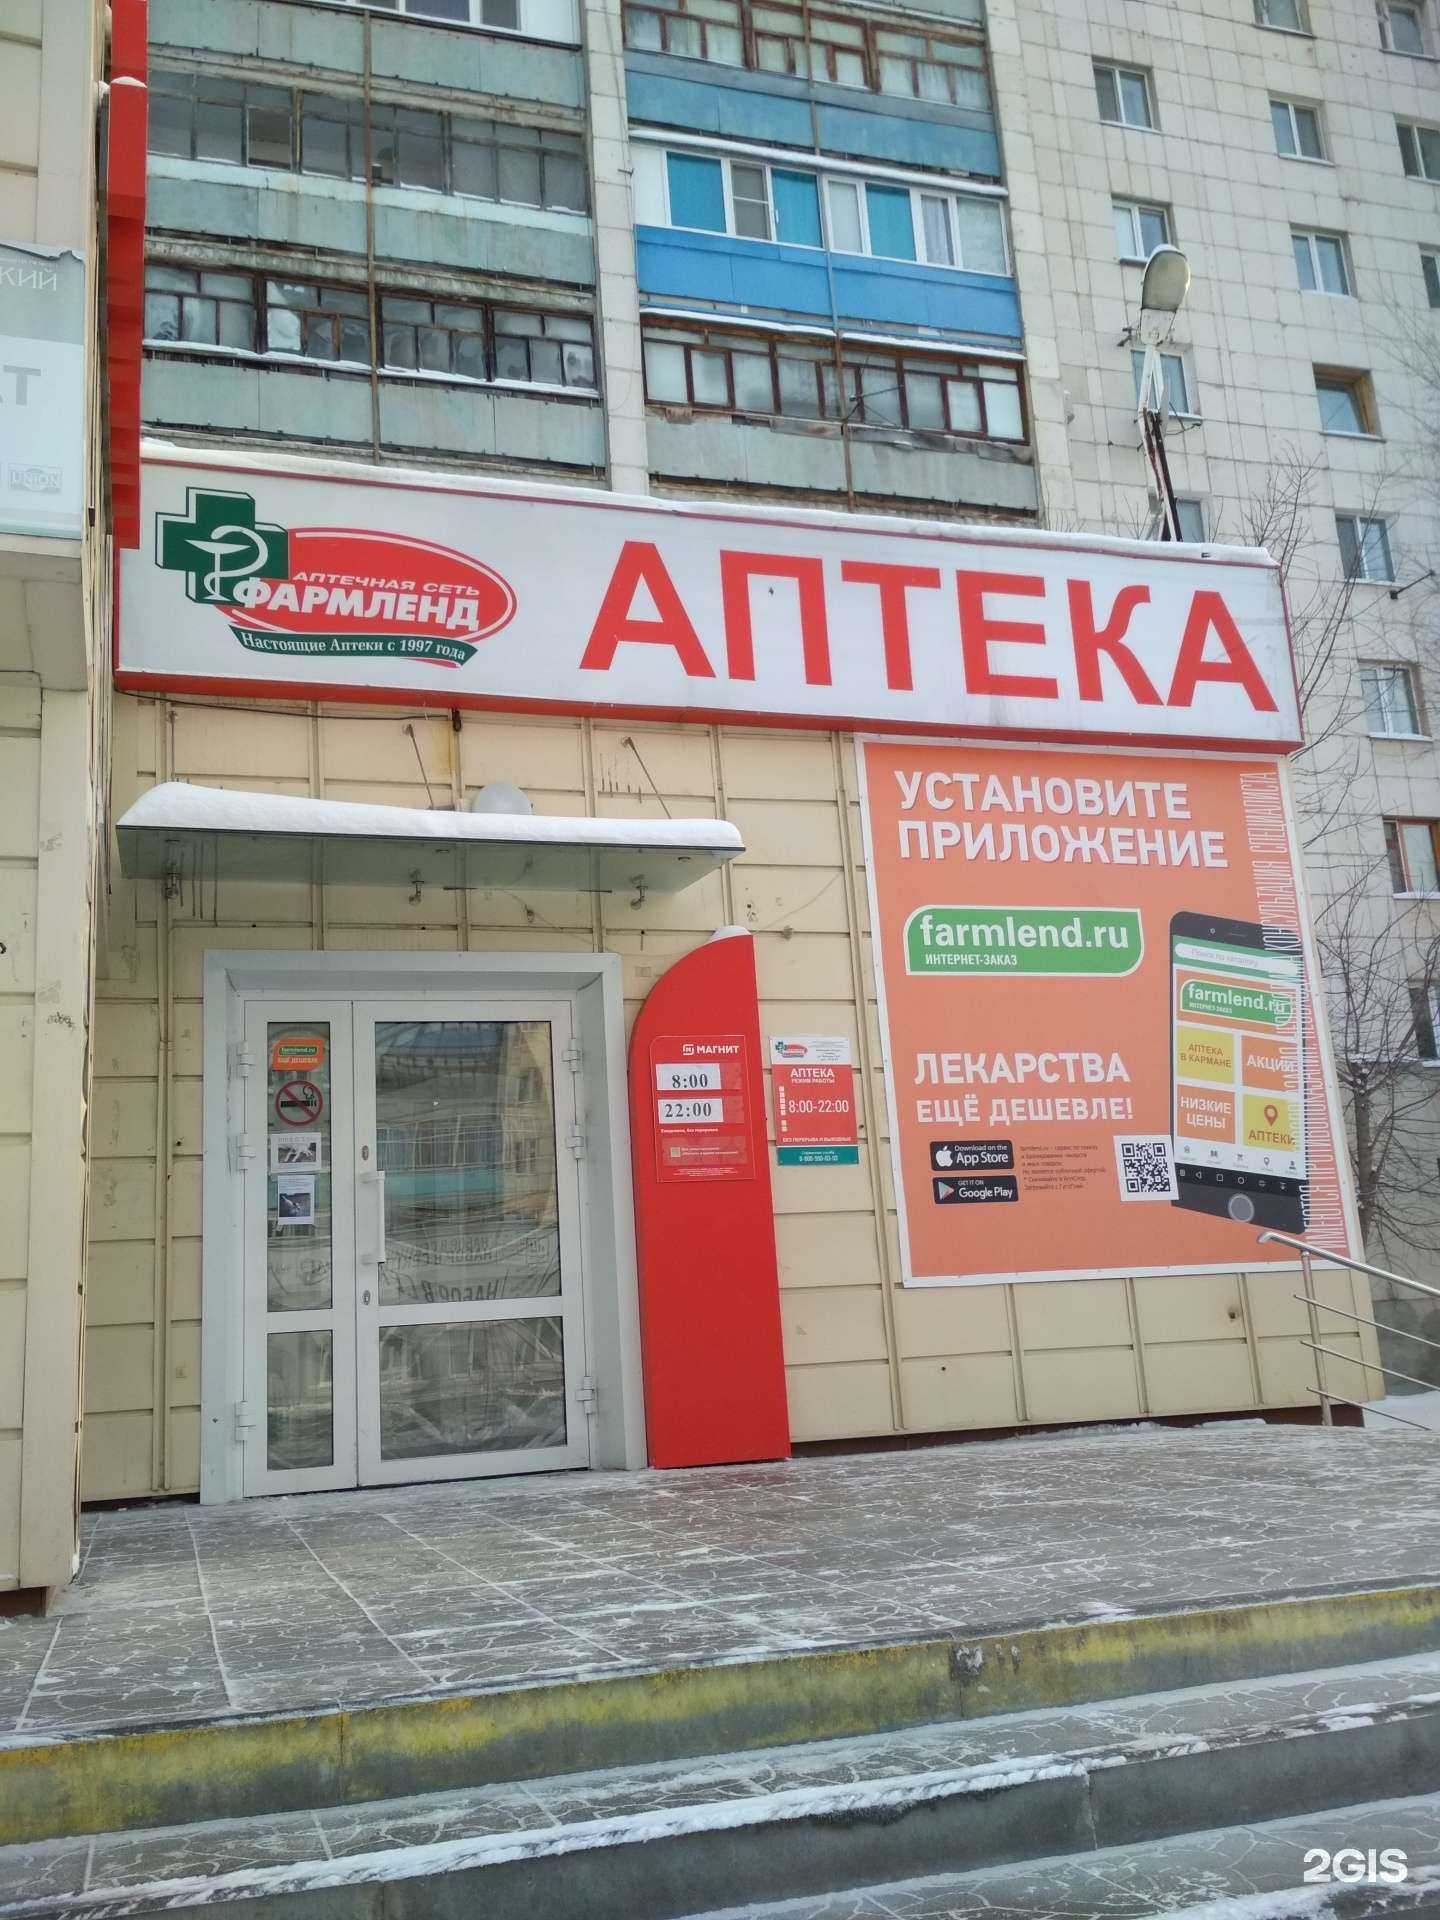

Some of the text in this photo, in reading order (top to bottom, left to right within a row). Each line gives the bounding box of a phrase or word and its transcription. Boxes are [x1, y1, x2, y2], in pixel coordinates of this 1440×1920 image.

[293, 571, 481, 596] АПТЕЧНАЯ СЕТЬ
[232, 576, 480, 632] ФАРМЛЕНД
[579, 539, 1280, 712] АПТЕКА
[241, 632, 466, 661] Настоящие Аптеки с 1997 года
[895, 770, 1192, 819] УСТАНОВИТЕ
[1240, 771, 1288, 854] СПЕЦИАЛИСТА
[898, 820, 1228, 868] ПРИЛОЖЕНИЕ
[1252, 860, 1304, 951] КОНСУЛЬТАЦИЯ
[919, 914, 1129, 949] farmlend.ru
[925, 953, 1018, 966] ИНТЕРНЕТ-ЗАКАЗ
[1187, 983, 1285, 1013] farmlend.ru
[697, 1045, 740, 1054] МАГНИТ
[1180, 1053, 1232, 1068] В КАРМАНЕ
[1188, 1043, 1223, 1056] АПТЕКА
[790, 1068, 835, 1078] АПТЕКА
[914, 1053, 1132, 1084] ЛЕКАРСТВА
[671, 1073, 708, 1088] 8:00
[664, 1102, 712, 1118] 22:00
[788, 1099, 850, 1113] 8:00-22:00
[916, 1094, 1134, 1126] ЕЩЁ ДЕШЕВЛЕ!
[1180, 1096, 1232, 1115] НИЗКИЕ
[1186, 1112, 1226, 1129] ЦЕНЫ
[956, 1153, 979, 1166] App
[980, 1152, 1009, 1164] Store
[958, 1187, 993, 1200] Google
[994, 1186, 1013, 1199] Play
